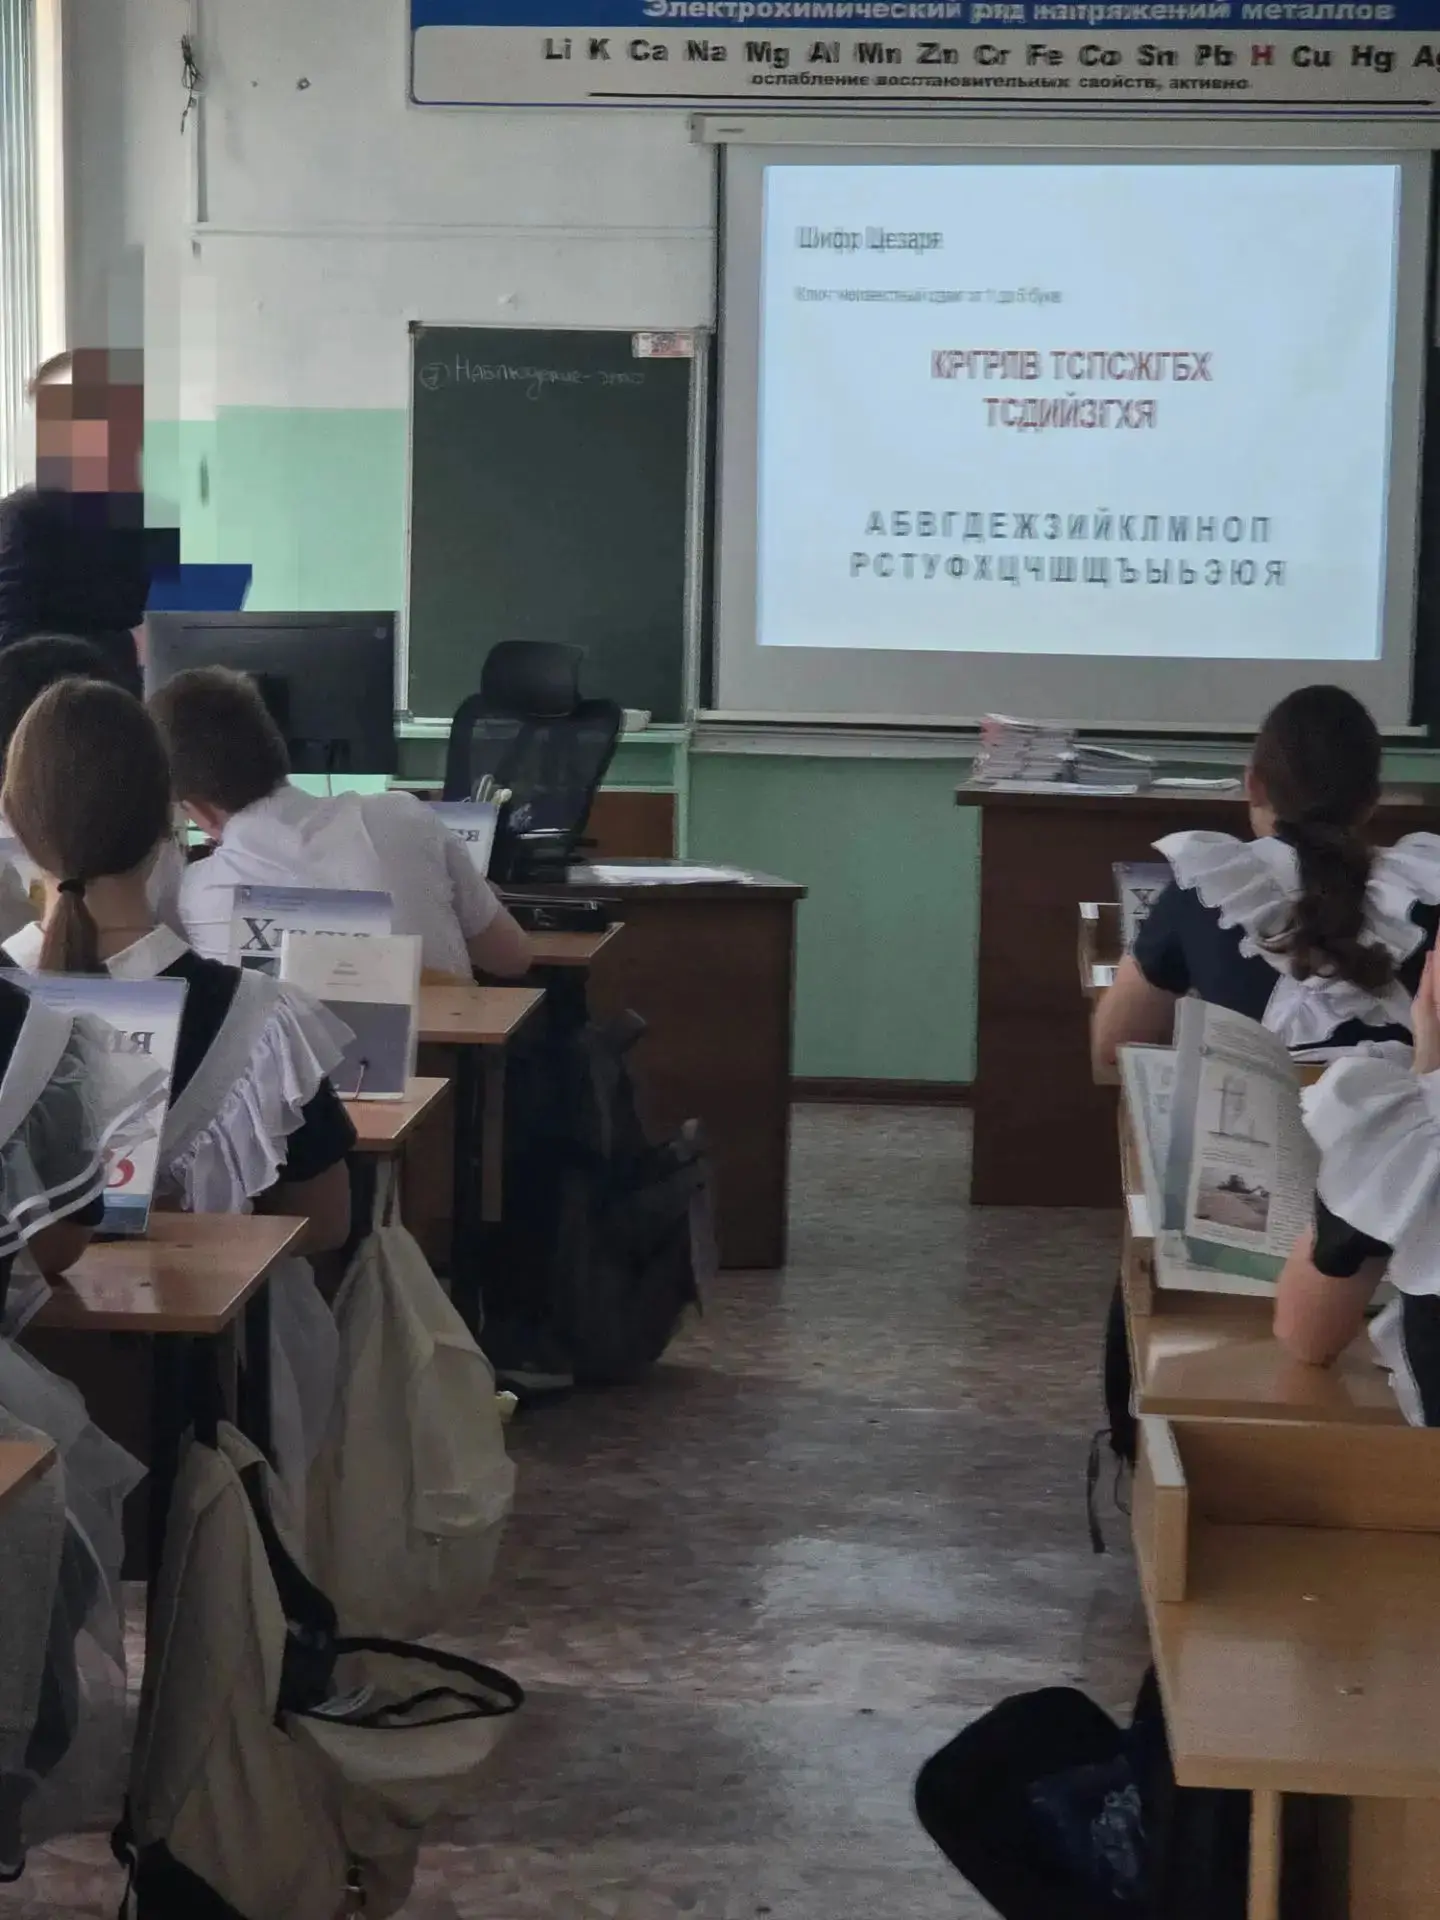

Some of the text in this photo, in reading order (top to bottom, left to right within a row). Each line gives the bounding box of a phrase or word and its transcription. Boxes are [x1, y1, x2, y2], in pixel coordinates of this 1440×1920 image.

[642, 0, 1396, 25] Электрохимический ряд напряжений металлов
[545, 38, 1440, 73] Li K Ca Na Mg Al Mn Zn Cr Fe Co Sn Pb H Cu Hg A
[751, 72, 871, 86] ослабление
[875, 75, 1070, 88] восстановительных
[796, 226, 863, 255] Шифр
